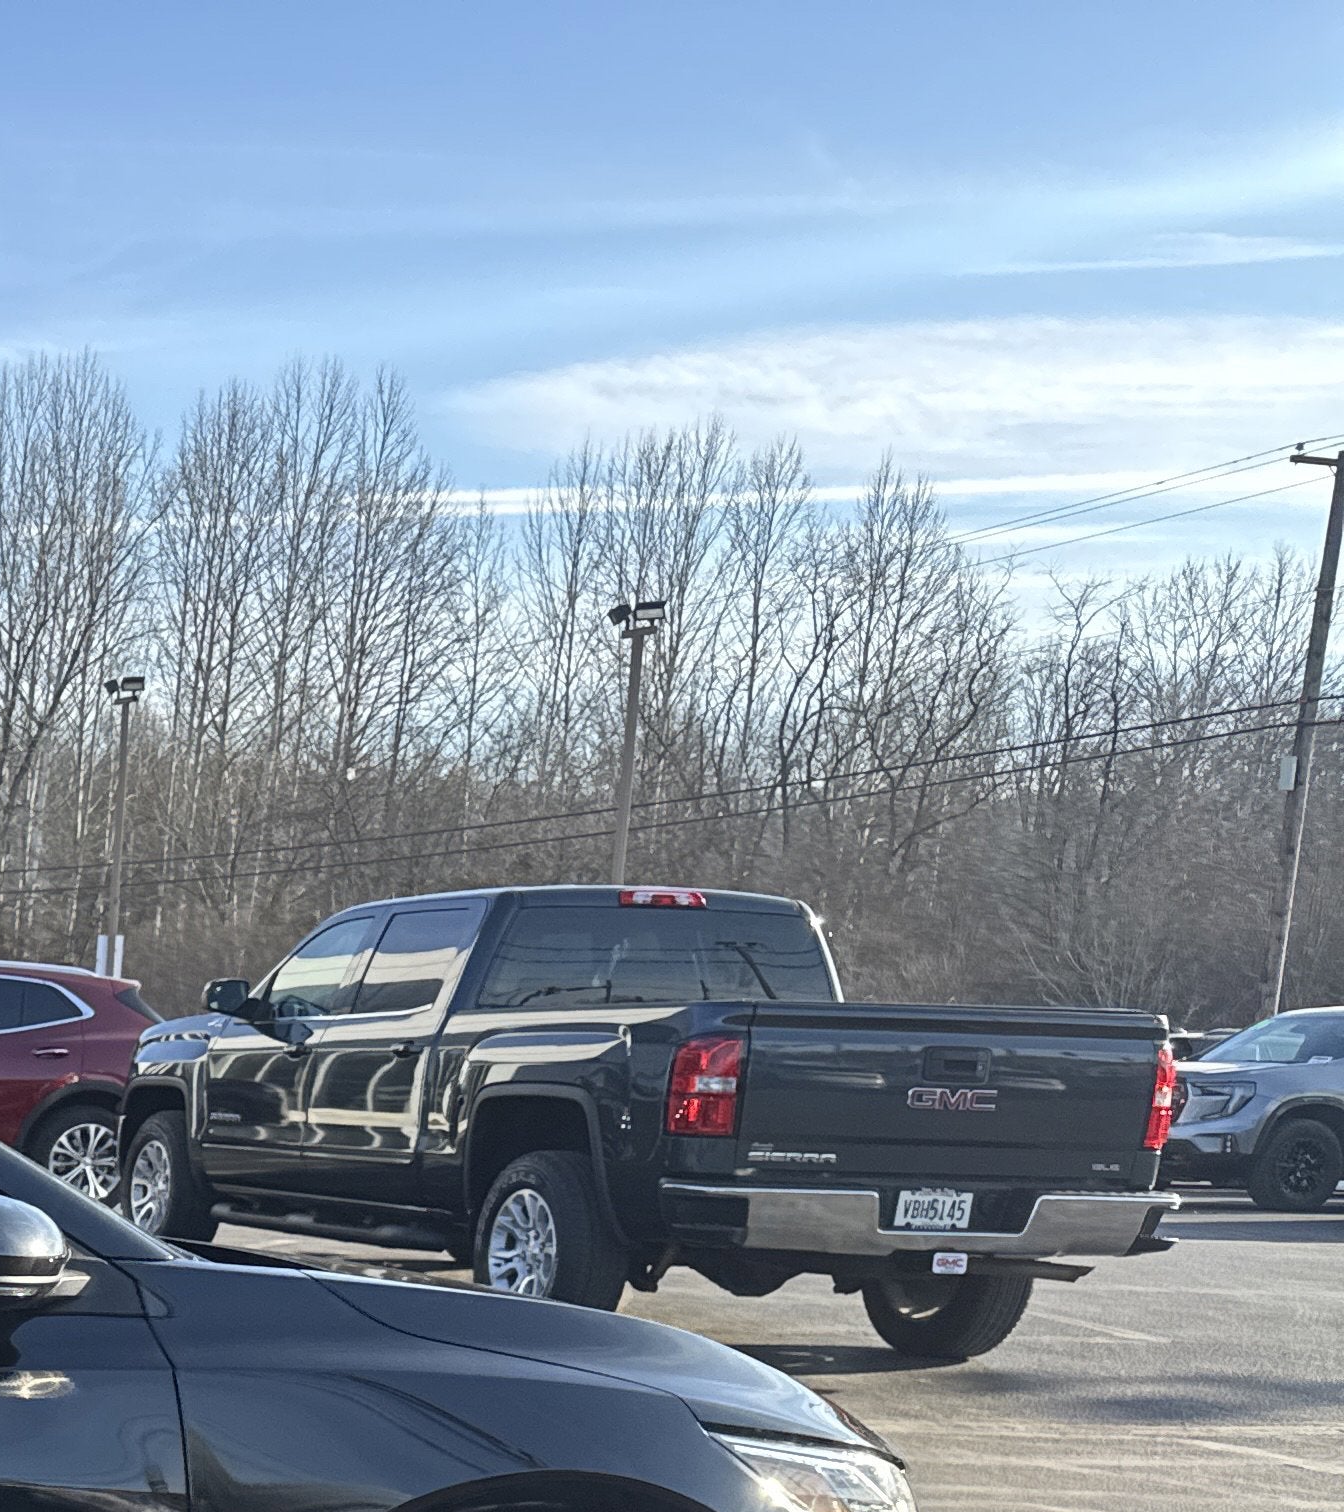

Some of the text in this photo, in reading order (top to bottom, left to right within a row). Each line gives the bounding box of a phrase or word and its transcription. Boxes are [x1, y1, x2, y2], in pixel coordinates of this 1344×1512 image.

[907, 1087, 998, 1111] GMC
[904, 1199, 967, 1221] VBH5145
[936, 1258, 964, 1268] GMC
